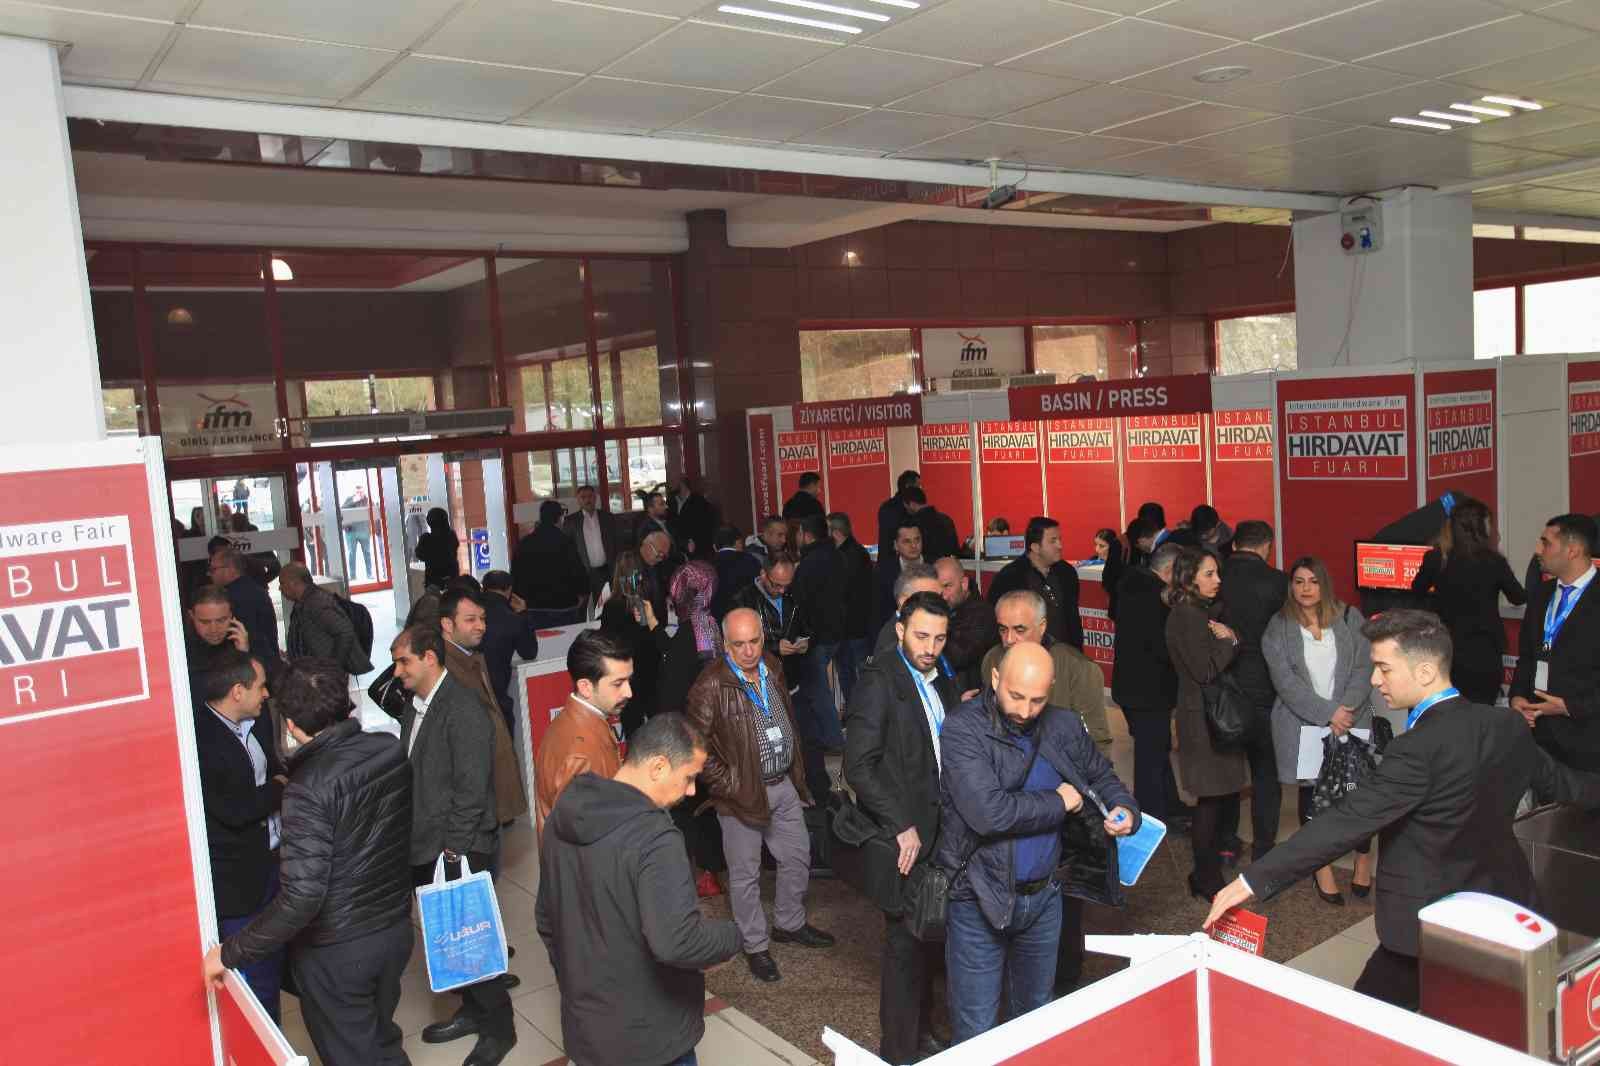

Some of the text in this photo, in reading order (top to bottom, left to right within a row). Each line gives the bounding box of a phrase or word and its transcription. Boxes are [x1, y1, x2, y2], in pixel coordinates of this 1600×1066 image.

[960, 342, 987, 361] ifm
[1041, 387, 1168, 412] BASIN / PRESS
[1289, 398, 1401, 410] International Hardware Fair
[203, 405, 252, 429] ifm
[864, 403, 912, 420] VISITOR
[1128, 416, 1200, 428] ISTANBUL
[1290, 414, 1401, 431] ISTANBUL
[922, 435, 970, 449] HIRDAVAT
[983, 434, 1035, 449] HIRDAVAT
[1050, 431, 1111, 448] HIRDAVAT
[1128, 429, 1198, 445] HIRDAVAT
[1289, 433, 1404, 457] HIRDAVAT
[1429, 426, 1491, 454] HIRDAVAT
[778, 445, 816, 460] DAVAT
[831, 437, 883, 455] HIRDAVAT
[1143, 447, 1185, 458] FUARI
[1313, 460, 1378, 474] FUARI
[0, 522, 116, 549] ware Fair
[7, 556, 122, 598] BUL
[13, 668, 68, 705] RI
